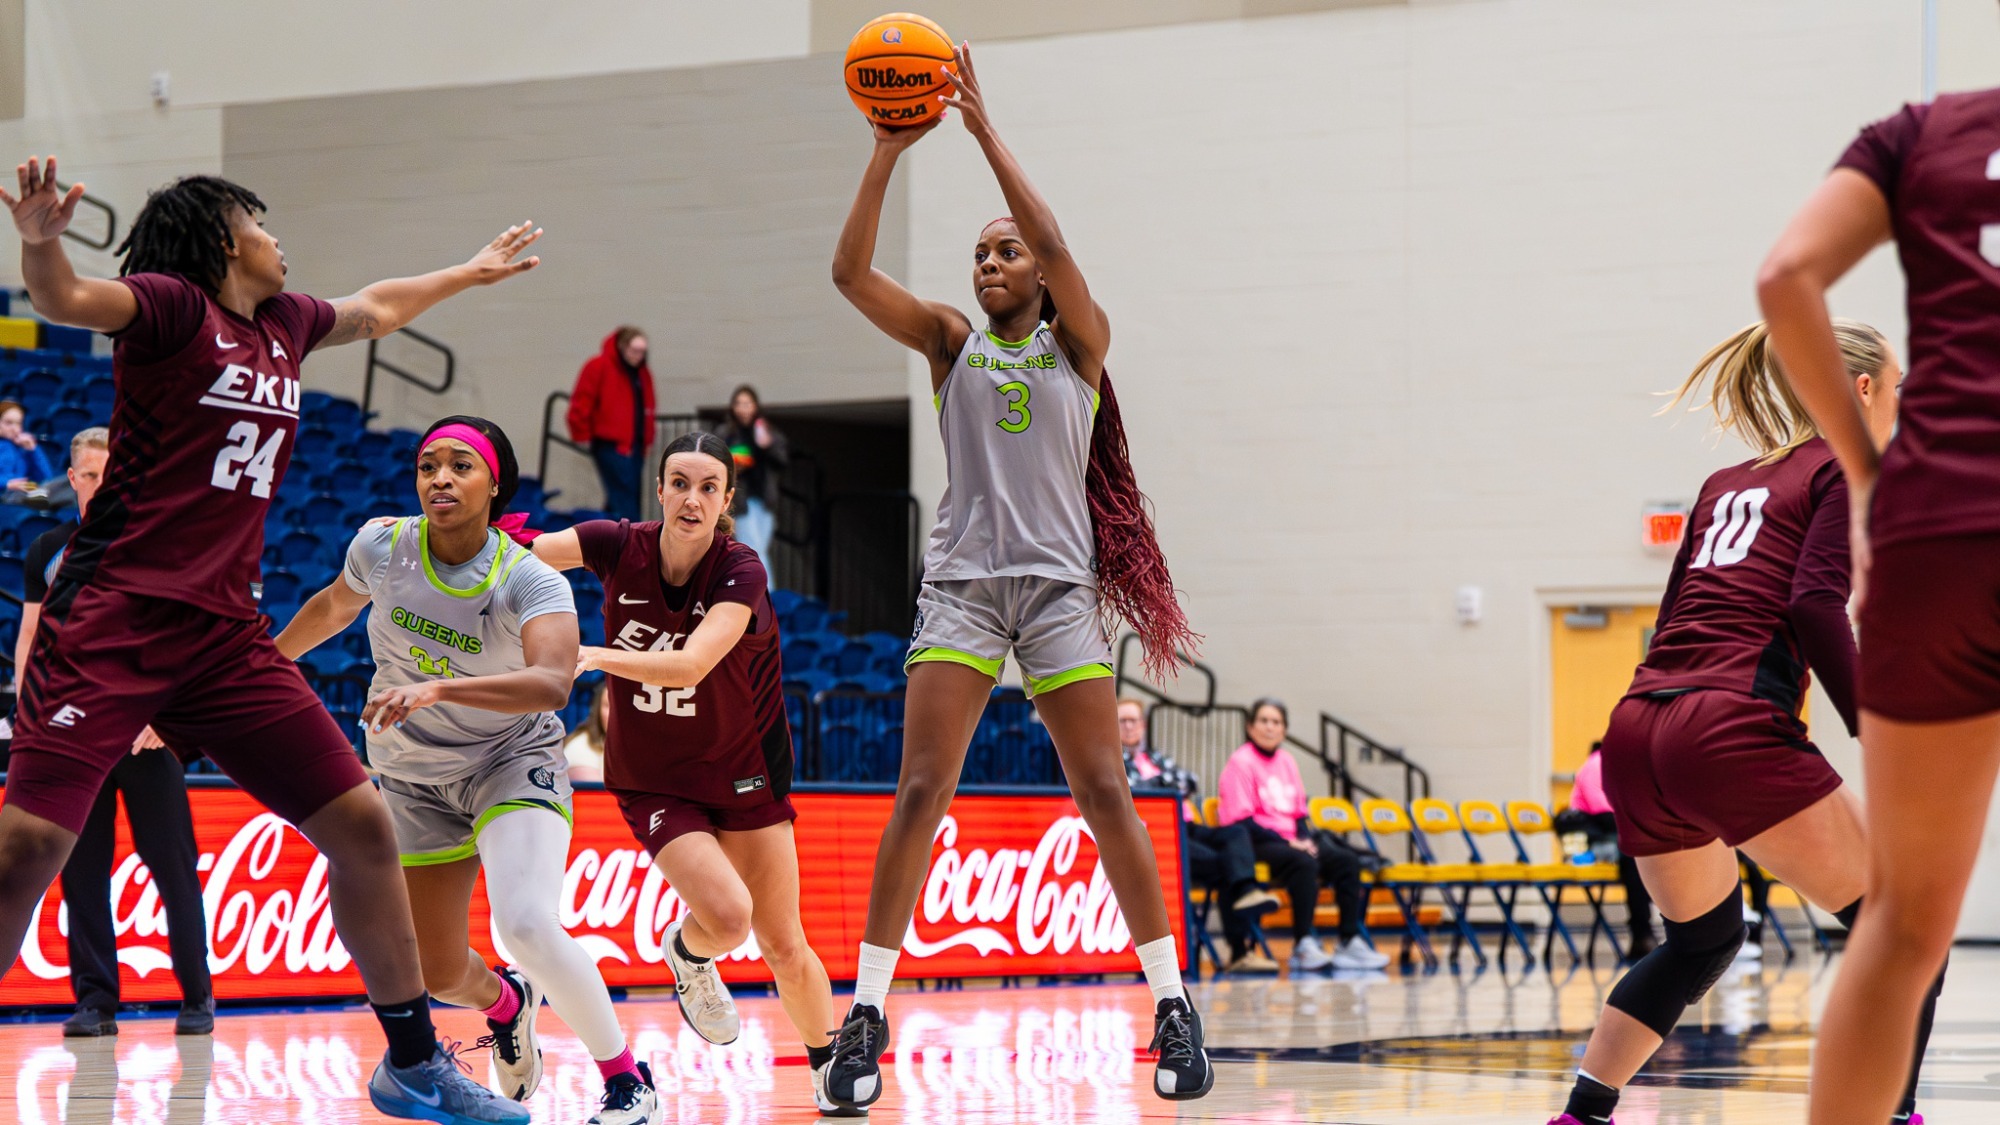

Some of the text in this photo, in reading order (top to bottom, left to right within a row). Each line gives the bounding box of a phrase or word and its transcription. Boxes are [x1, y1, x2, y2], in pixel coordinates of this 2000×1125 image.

[857, 67, 933, 89] Wilson
[871, 102, 929, 120] NCAA
[208, 363, 300, 412] EKU
[996, 381, 1032, 434] 3
[211, 420, 286, 499] 24
[1688, 487, 1770, 569] 10
[391, 606, 482, 655] QUEENS
[617, 619, 690, 652] EK
